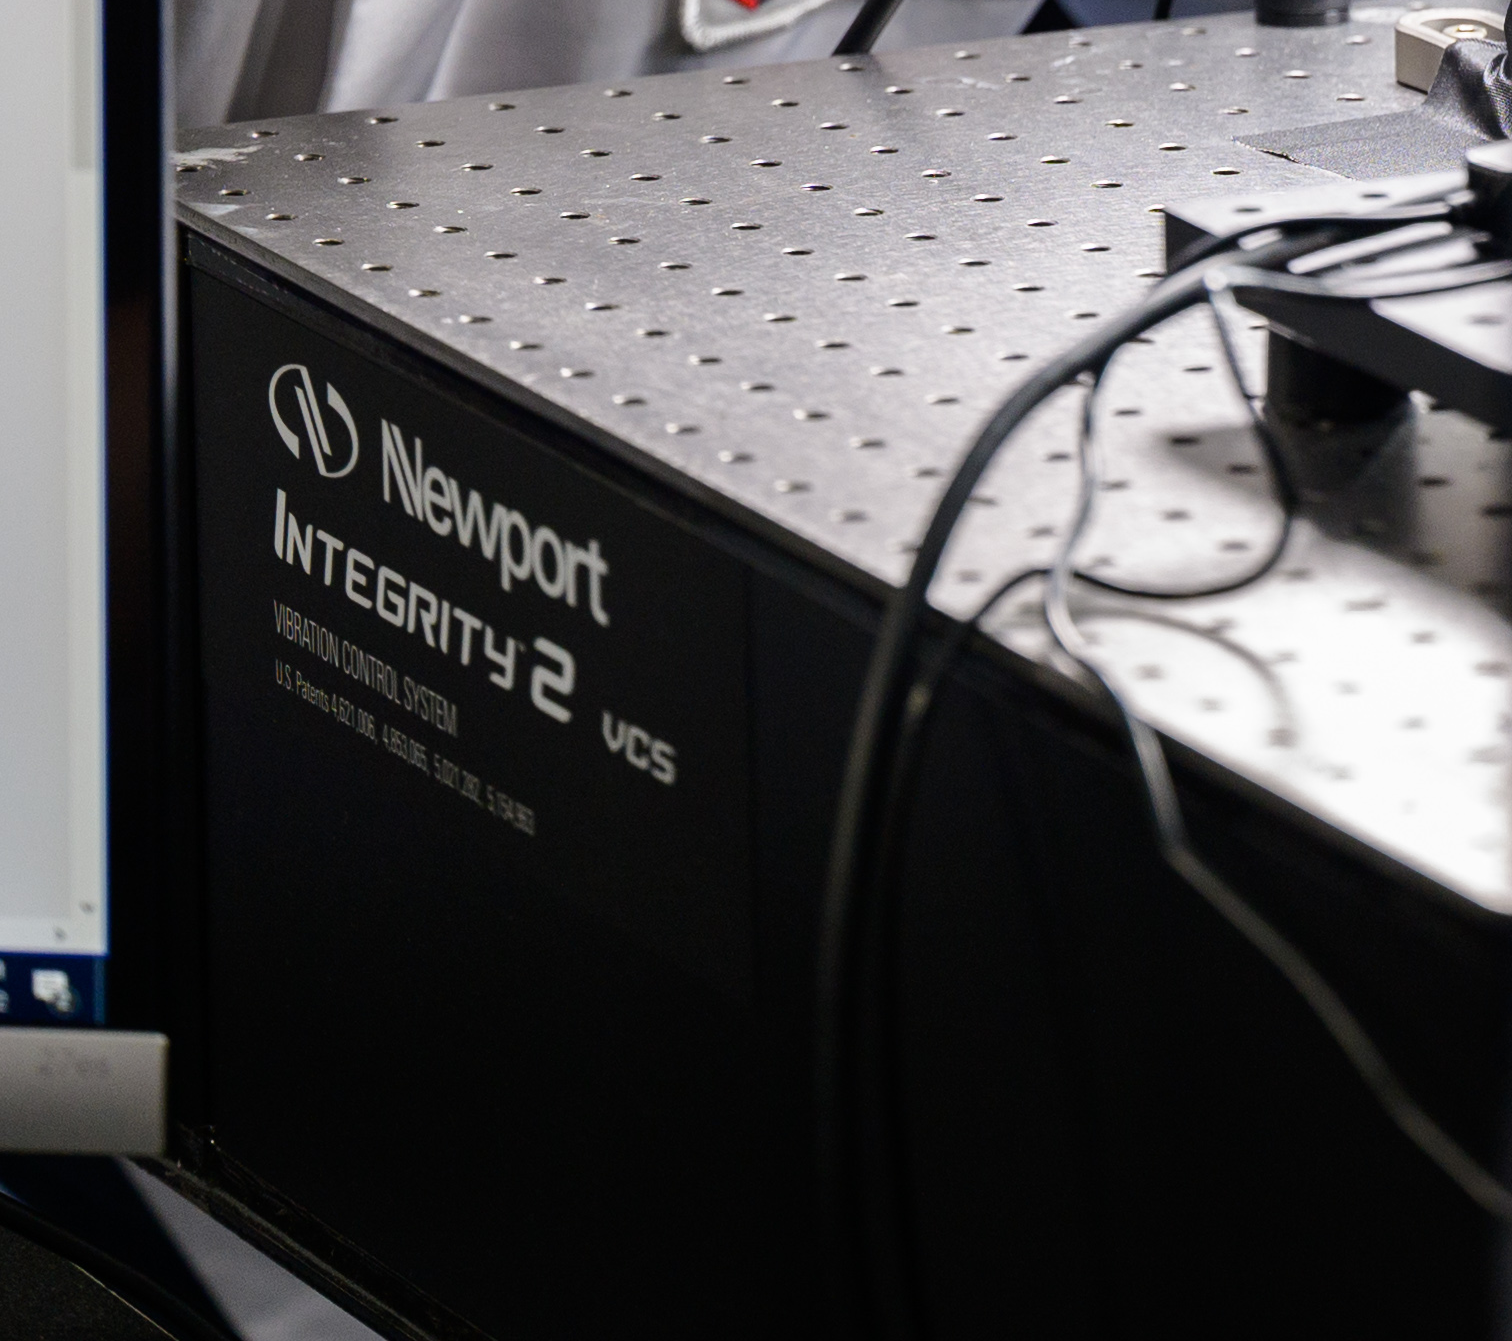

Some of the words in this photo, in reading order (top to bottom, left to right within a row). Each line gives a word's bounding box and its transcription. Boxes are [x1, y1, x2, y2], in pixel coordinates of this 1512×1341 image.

[381, 418, 610, 627] Newport
[273, 598, 339, 669] VIBRATION
[341, 639, 401, 706] CONTROL
[403, 675, 458, 739] SYSTEM
[275, 658, 294, 693] U.S.
[296, 670, 329, 713] Patents
[530, 635, 578, 724] 2
